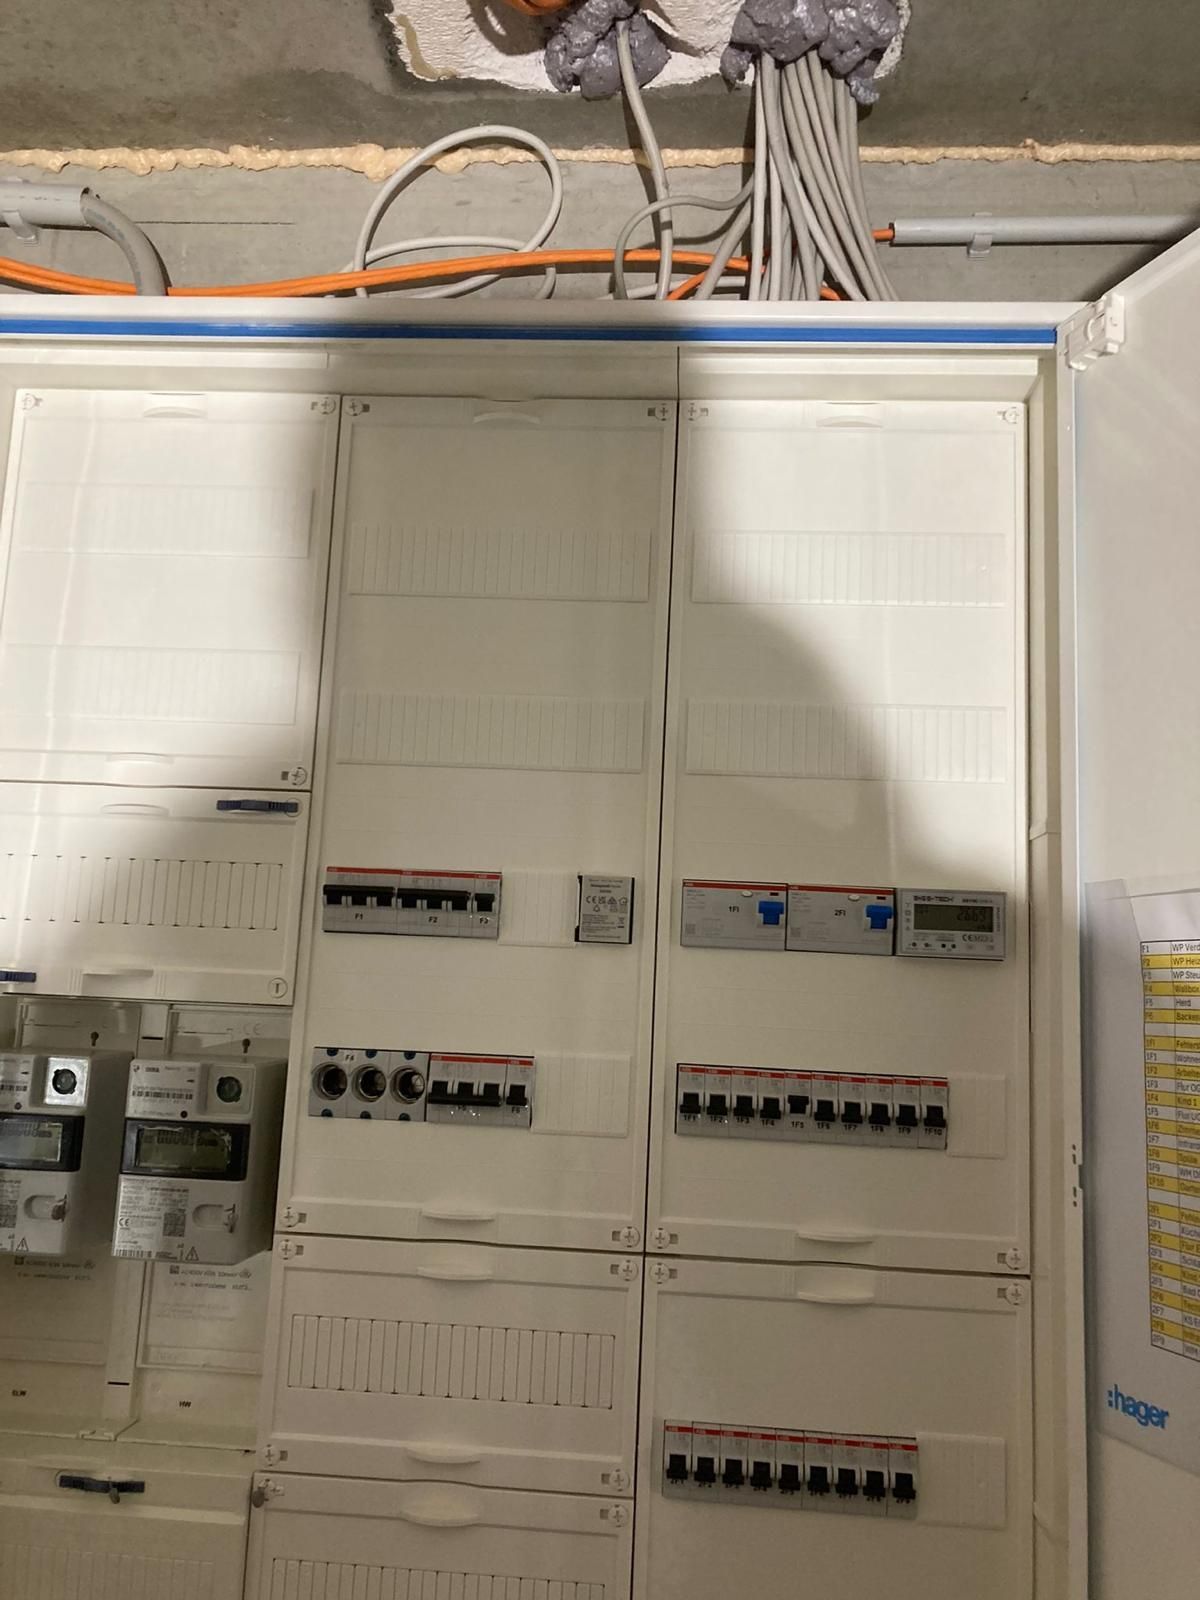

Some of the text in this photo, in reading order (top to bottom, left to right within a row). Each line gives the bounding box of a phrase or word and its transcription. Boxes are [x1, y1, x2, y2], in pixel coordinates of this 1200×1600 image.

[354, 913, 364, 921] F1
[1142, 944, 1150, 953] F1
[1172, 944, 1184, 952] WP
[1172, 957, 1184, 965] WP
[1172, 971, 1184, 979] WP
